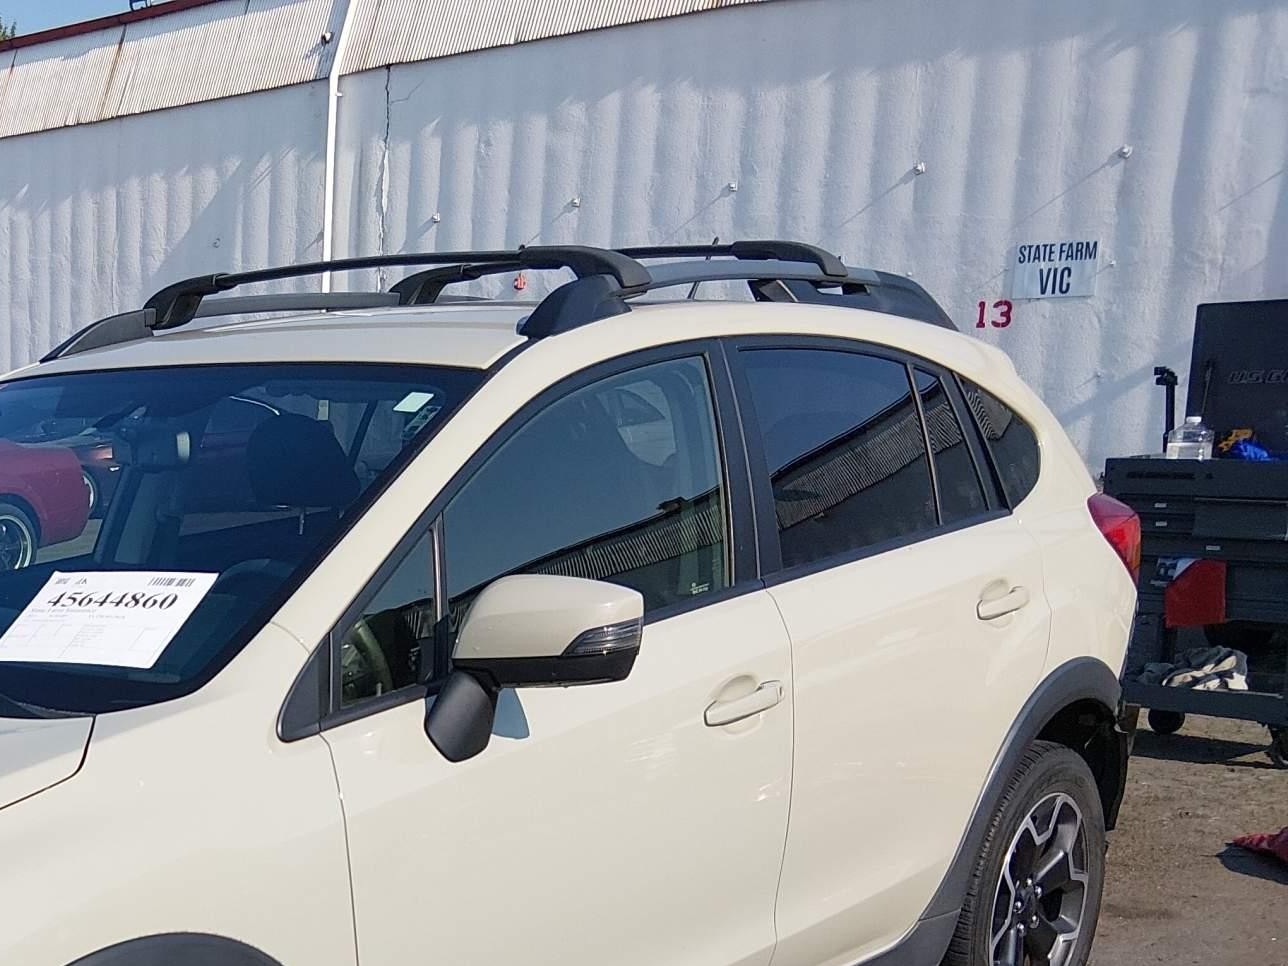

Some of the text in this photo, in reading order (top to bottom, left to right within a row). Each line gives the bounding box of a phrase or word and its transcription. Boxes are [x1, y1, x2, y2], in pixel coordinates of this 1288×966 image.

[1018, 241, 1098, 264] STATE FARM
[1039, 267, 1072, 295] VIC
[976, 300, 1012, 328] 13
[48, 592, 178, 610] 45644860
